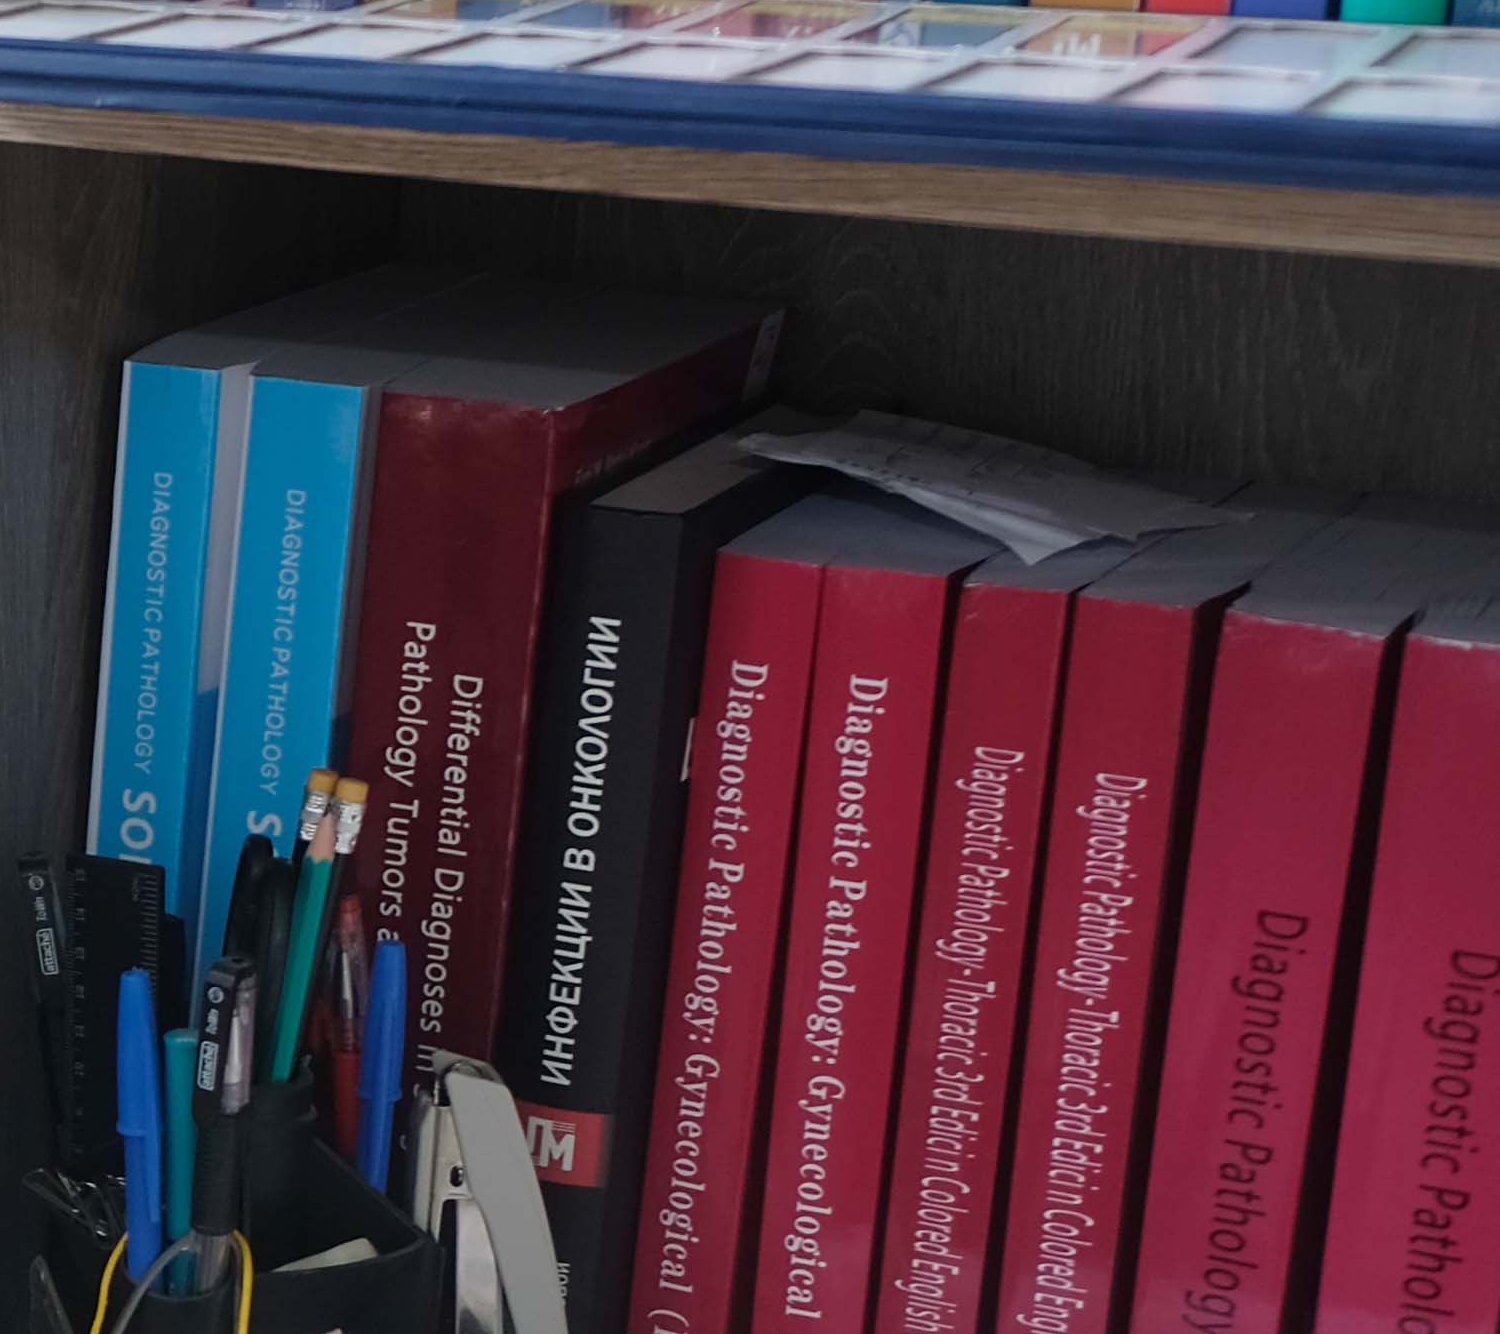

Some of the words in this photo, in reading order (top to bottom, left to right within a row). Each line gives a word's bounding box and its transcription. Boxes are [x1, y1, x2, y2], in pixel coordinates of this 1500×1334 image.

[144, 471, 174, 622] DIAGNOSTIC
[274, 488, 308, 641] DIAGNOSTIC
[131, 625, 164, 775] PATHOLOGY
[259, 645, 293, 796] PATHOLOGY
[384, 619, 437, 789] Pathology
[433, 673, 485, 858] Differential
[566, 616, 622, 838] ОНКОЛОГИИ
[711, 659, 770, 851] Diagnostic
[830, 674, 889, 868] Diagnostic
[120, 787, 158, 865] SO
[379, 798, 421, 921] Tumors
[567, 847, 596, 872] В
[955, 746, 1025, 860] Diagnostic
[1076, 772, 1148, 888] Diagnostic
[419, 865, 469, 1034] Diagnoses
[540, 875, 594, 1087] ИНФЕКЦИИ
[683, 857, 745, 1044] Pathology:
[805, 875, 867, 1065] Pathology:
[1227, 908, 1309, 1131] Diagnostic
[932, 1066, 985, 1106] 3rd
[1053, 1098, 1108, 1138] 3rd
[1420, 948, 1500, 1175] Diagnostic
[659, 1053, 721, 1293] Gynecological
[784, 1074, 846, 1319] Gynecological
[913, 1175, 971, 1260] Colored
[894, 1258, 960, 1331] English
[1036, 1208, 1095, 1294] Colored
